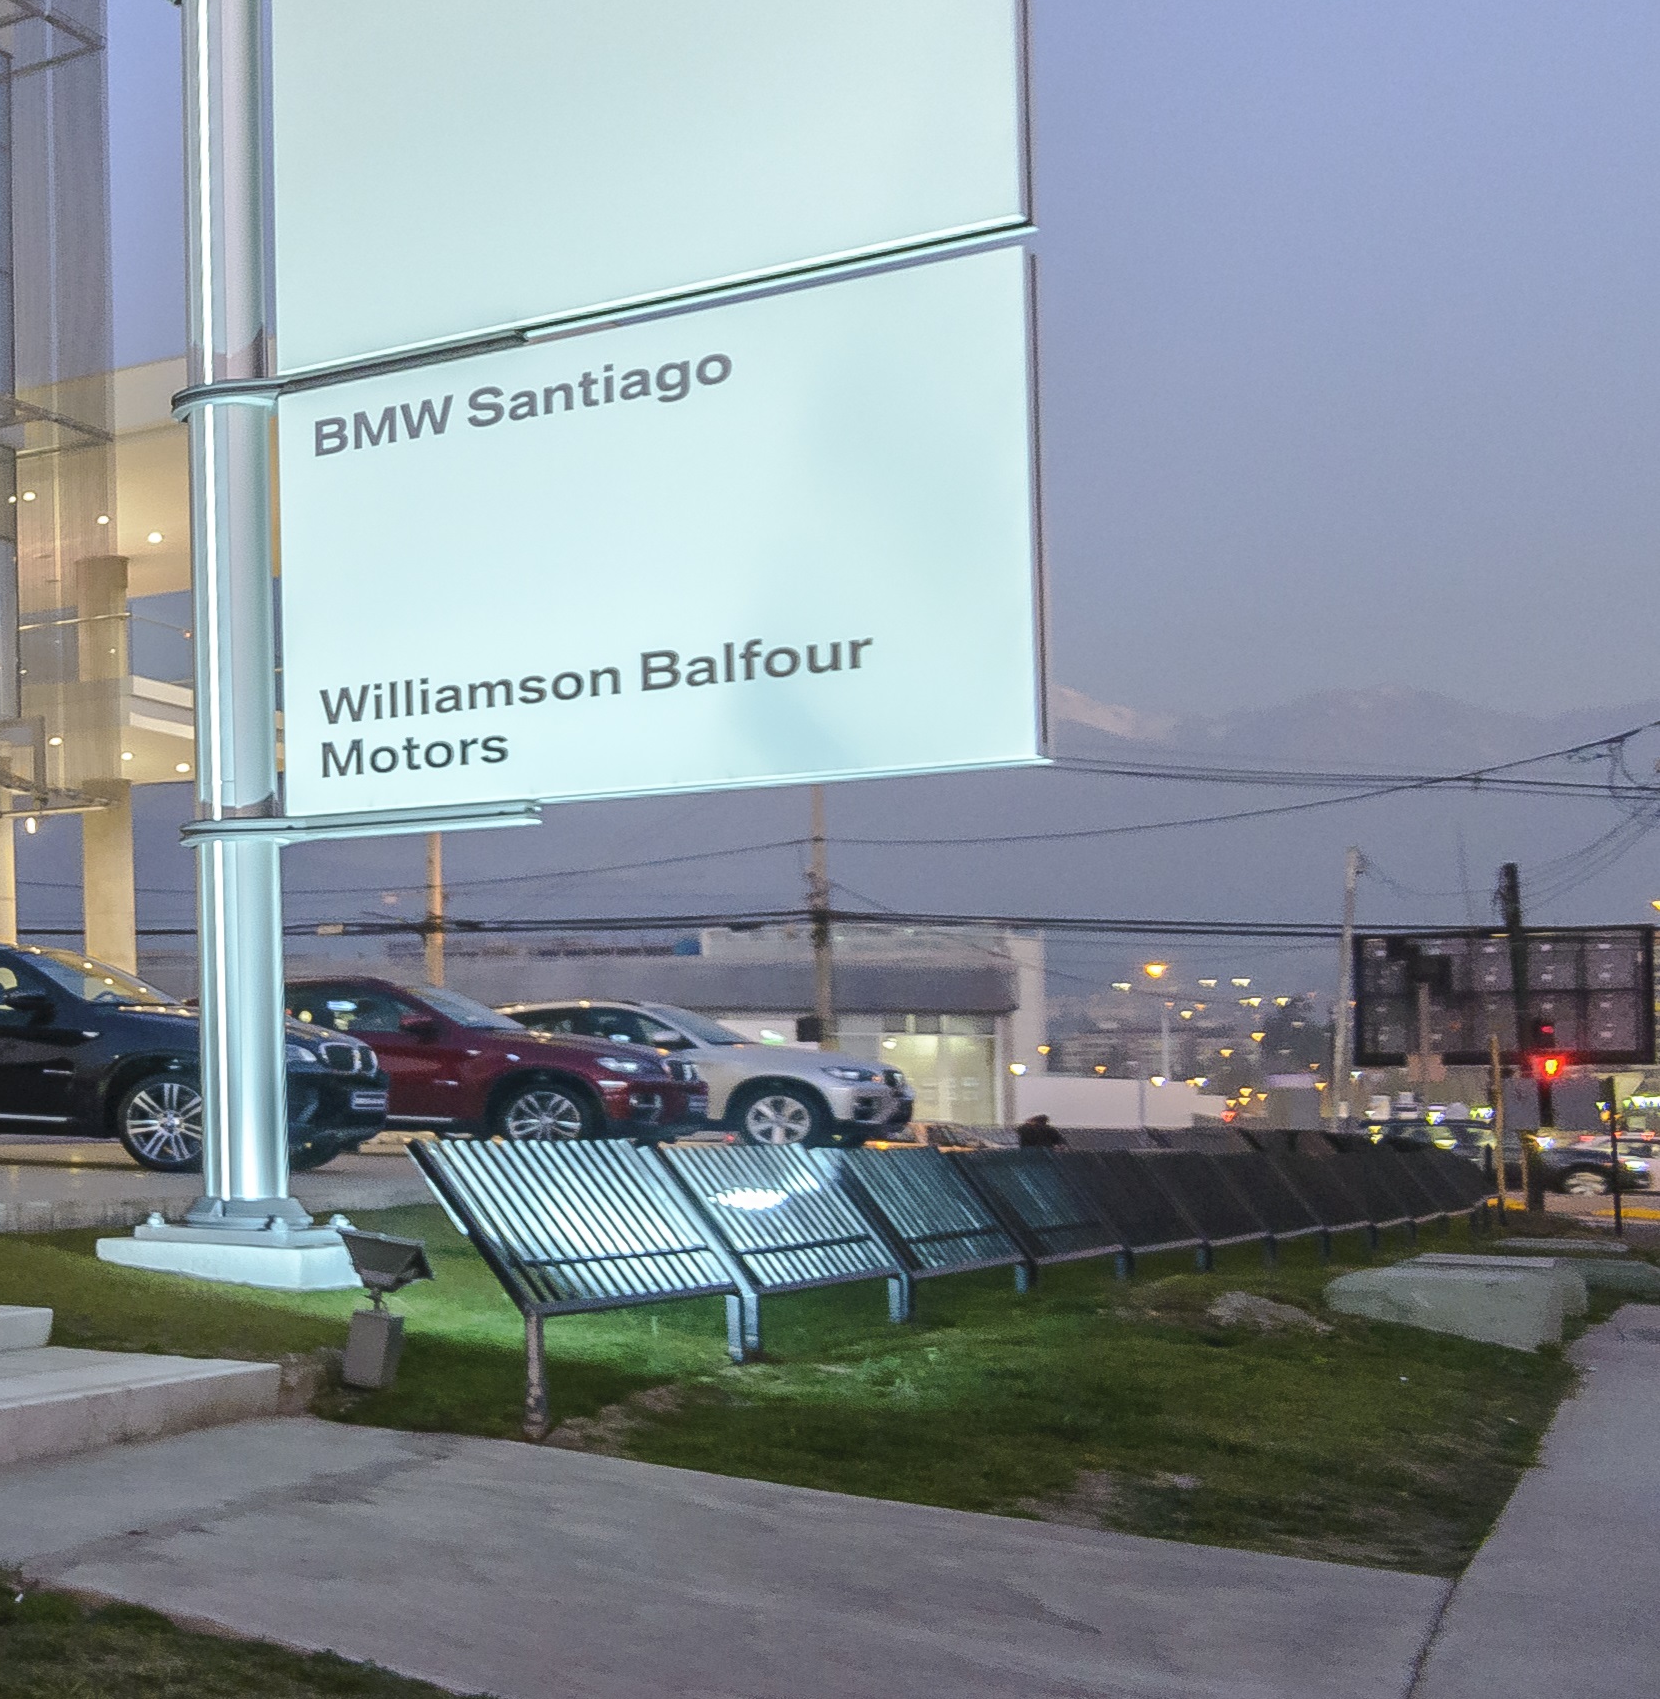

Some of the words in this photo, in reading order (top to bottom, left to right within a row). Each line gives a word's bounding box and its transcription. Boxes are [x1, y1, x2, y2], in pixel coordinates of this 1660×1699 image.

[314, 394, 454, 458] BMW
[467, 352, 733, 428] Santiago
[319, 666, 622, 725] Williamson
[640, 637, 874, 692] Balfour
[321, 735, 509, 779] Motors
